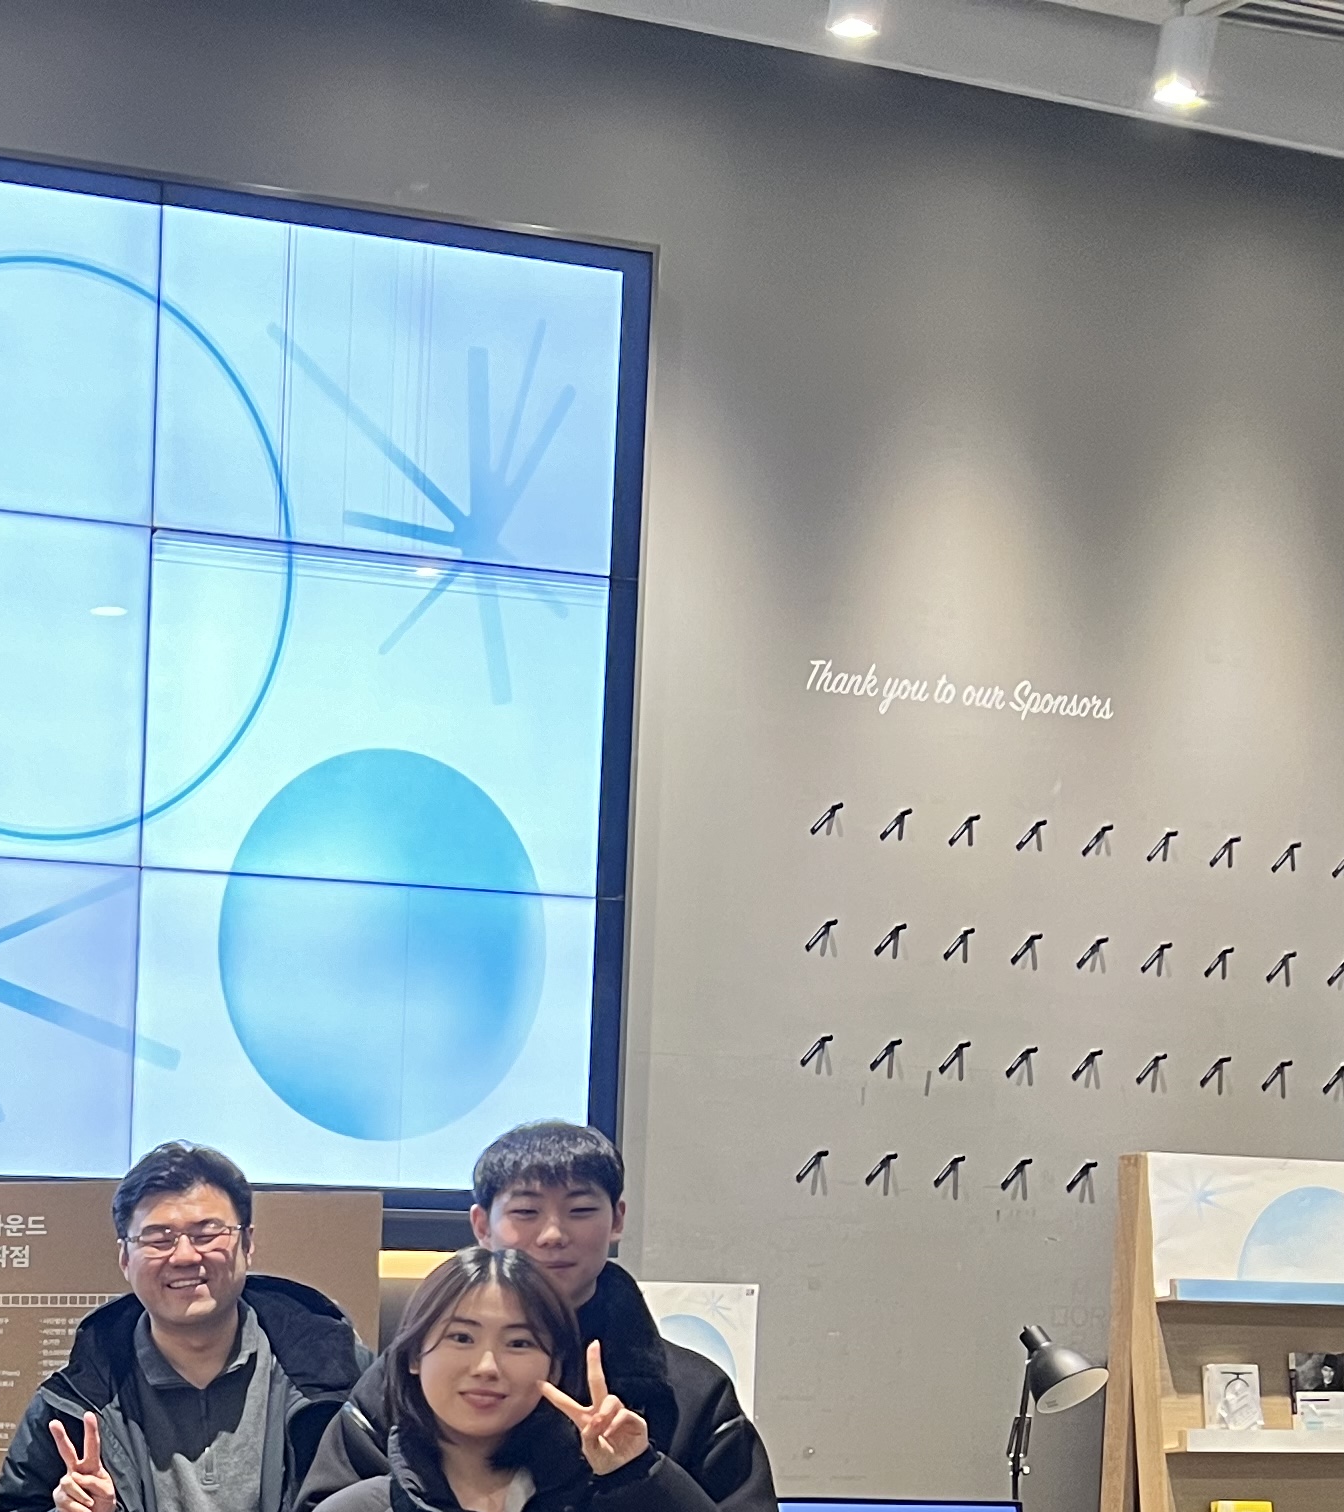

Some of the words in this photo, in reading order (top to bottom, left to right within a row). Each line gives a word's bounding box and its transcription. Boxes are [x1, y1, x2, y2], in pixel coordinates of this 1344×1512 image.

[806, 659, 879, 697] Thank
[879, 676, 929, 714] you
[933, 674, 956, 704] to
[962, 684, 1005, 710] our
[1009, 680, 1114, 721] Sponsors
